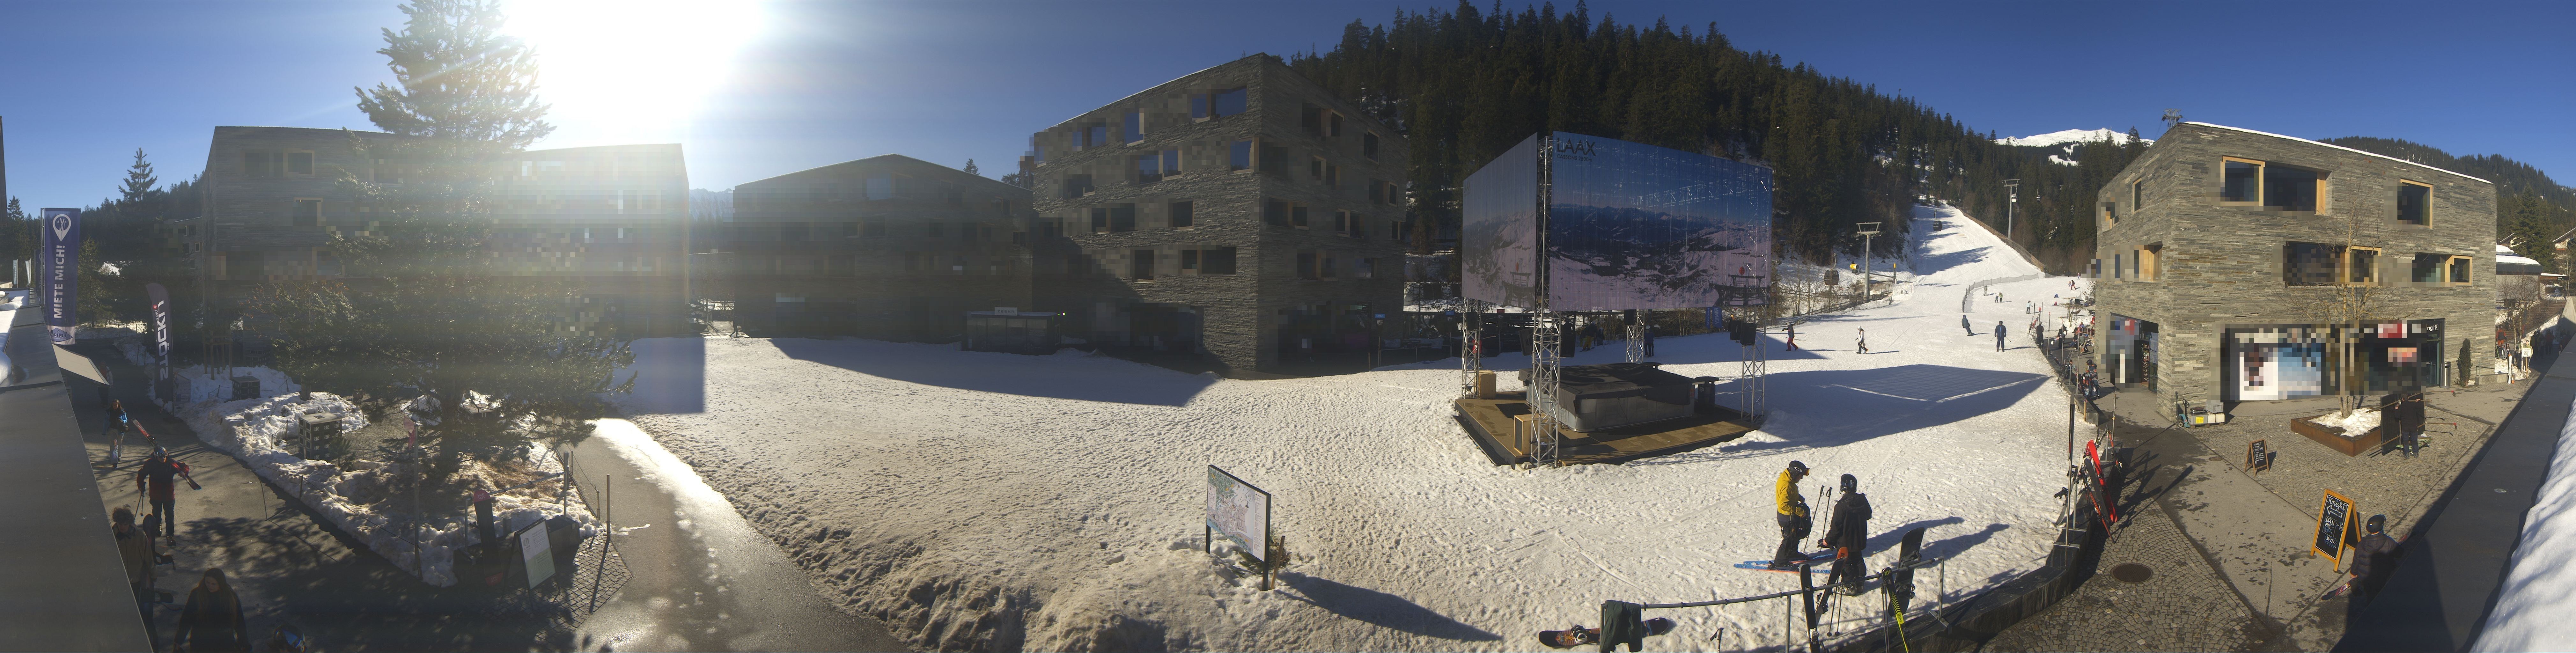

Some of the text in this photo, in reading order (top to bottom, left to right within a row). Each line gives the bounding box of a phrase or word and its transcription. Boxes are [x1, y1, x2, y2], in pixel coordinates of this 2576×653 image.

[1557, 138, 1596, 156] LAAX
[54, 245, 65, 318] MIETE MICH!
[2327, 496, 2348, 511] Tonight
[2326, 517, 2335, 526] OPEN
